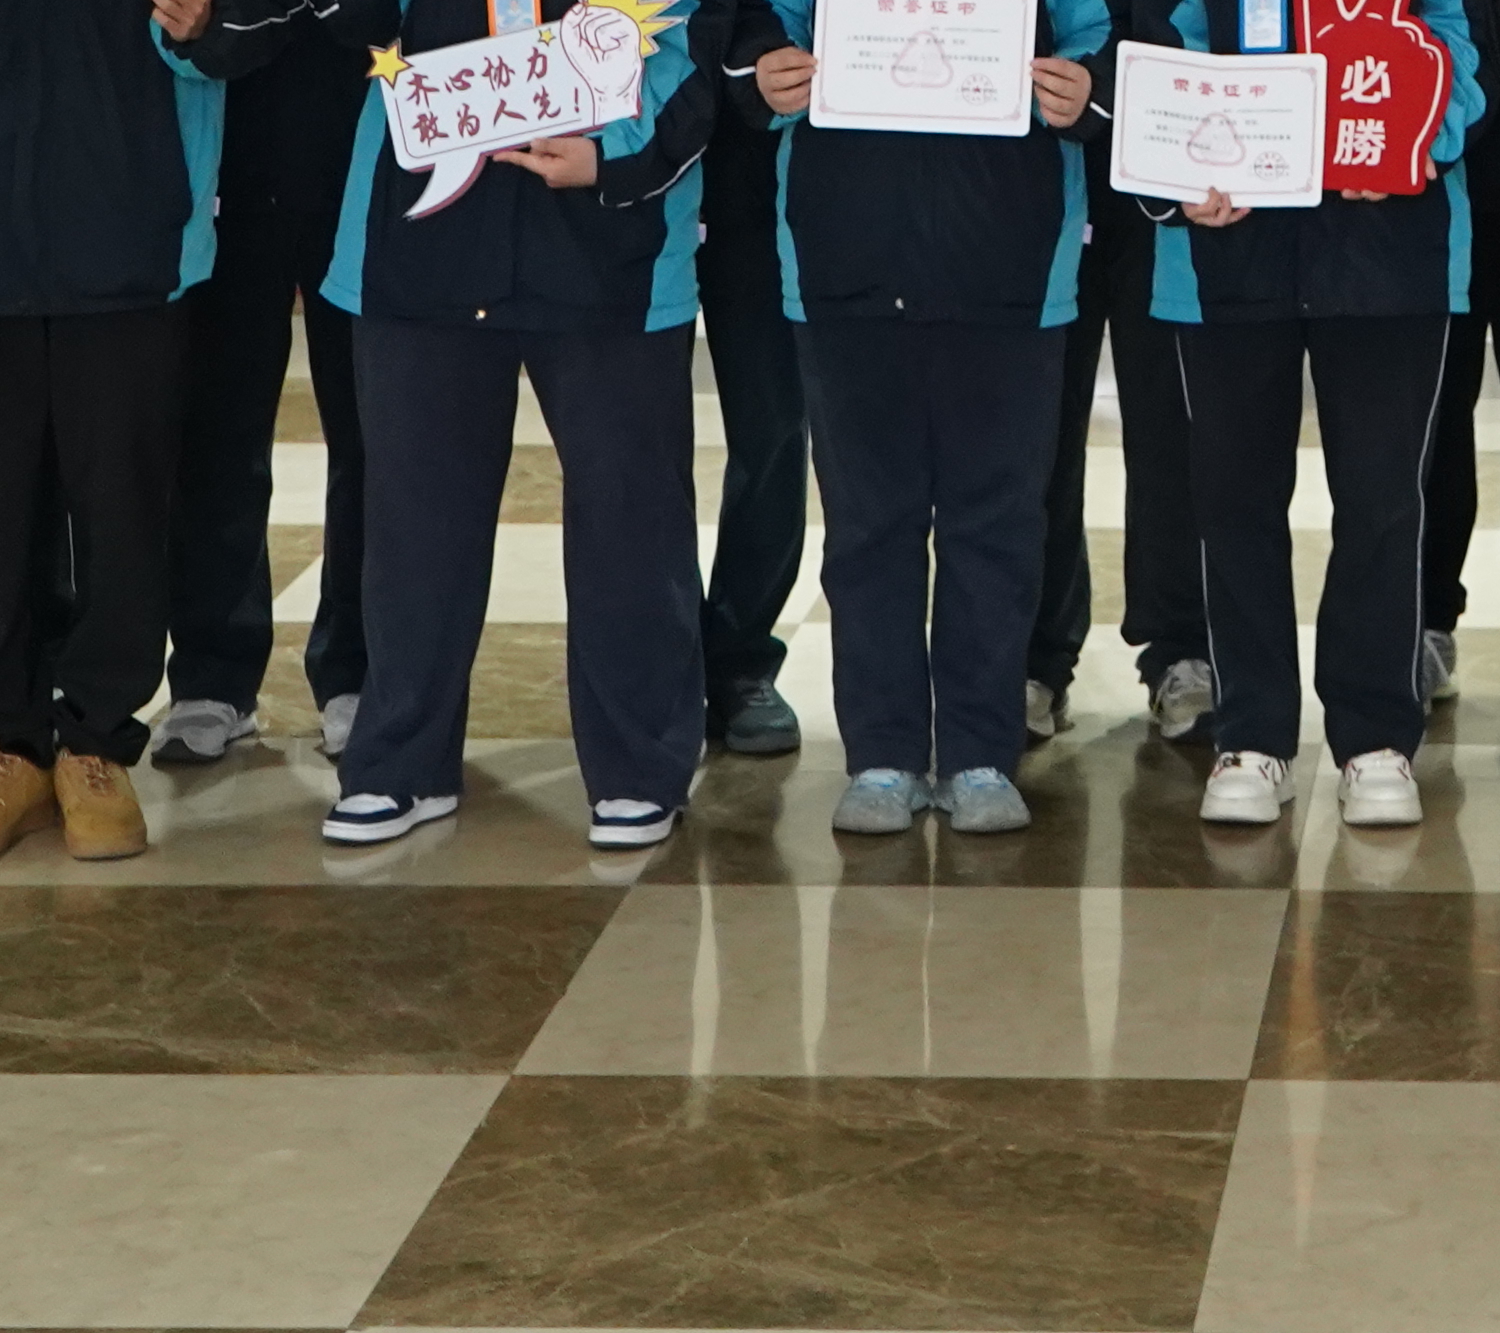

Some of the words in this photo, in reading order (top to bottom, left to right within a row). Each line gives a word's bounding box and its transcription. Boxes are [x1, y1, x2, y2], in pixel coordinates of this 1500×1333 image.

[406, 46, 549, 107] 齐心协力
[412, 85, 582, 148] 敢为人先！
[1333, 55, 1392, 167] 必勝
